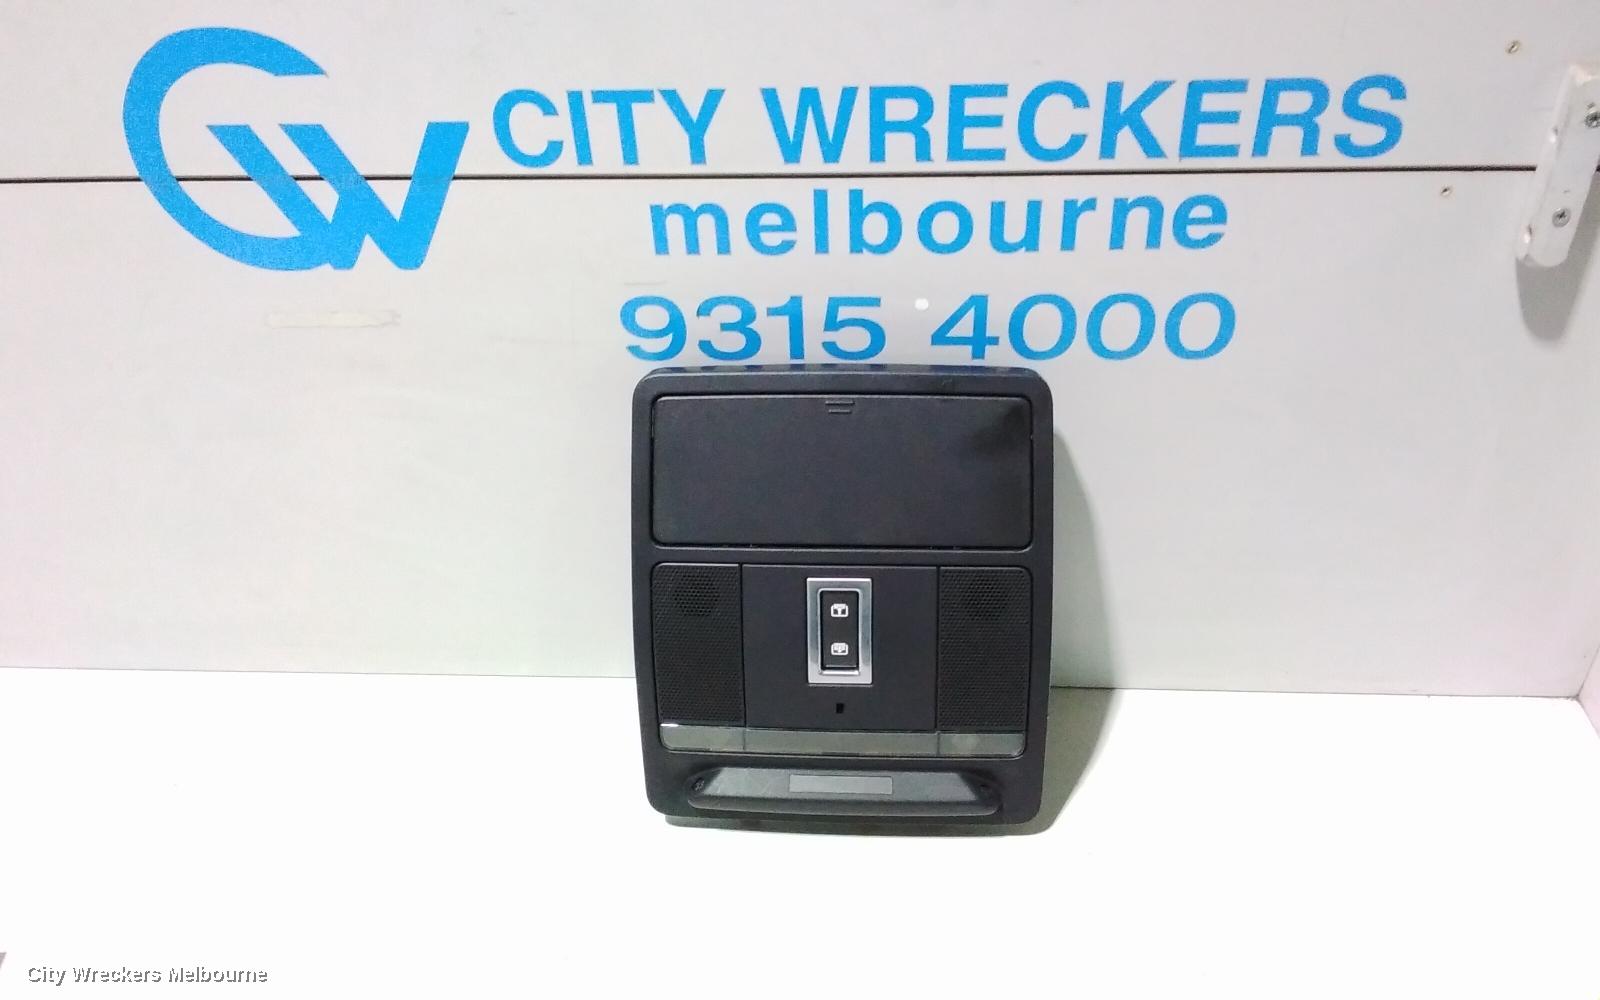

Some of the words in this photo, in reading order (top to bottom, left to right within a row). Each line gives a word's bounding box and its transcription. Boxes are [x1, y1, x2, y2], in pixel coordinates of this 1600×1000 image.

[492, 88, 726, 168] CITY
[761, 74, 1408, 164] WRECKERS
[650, 188, 1229, 256] melbourne
[619, 295, 887, 362] 9315
[930, 292, 1236, 361] 4000
